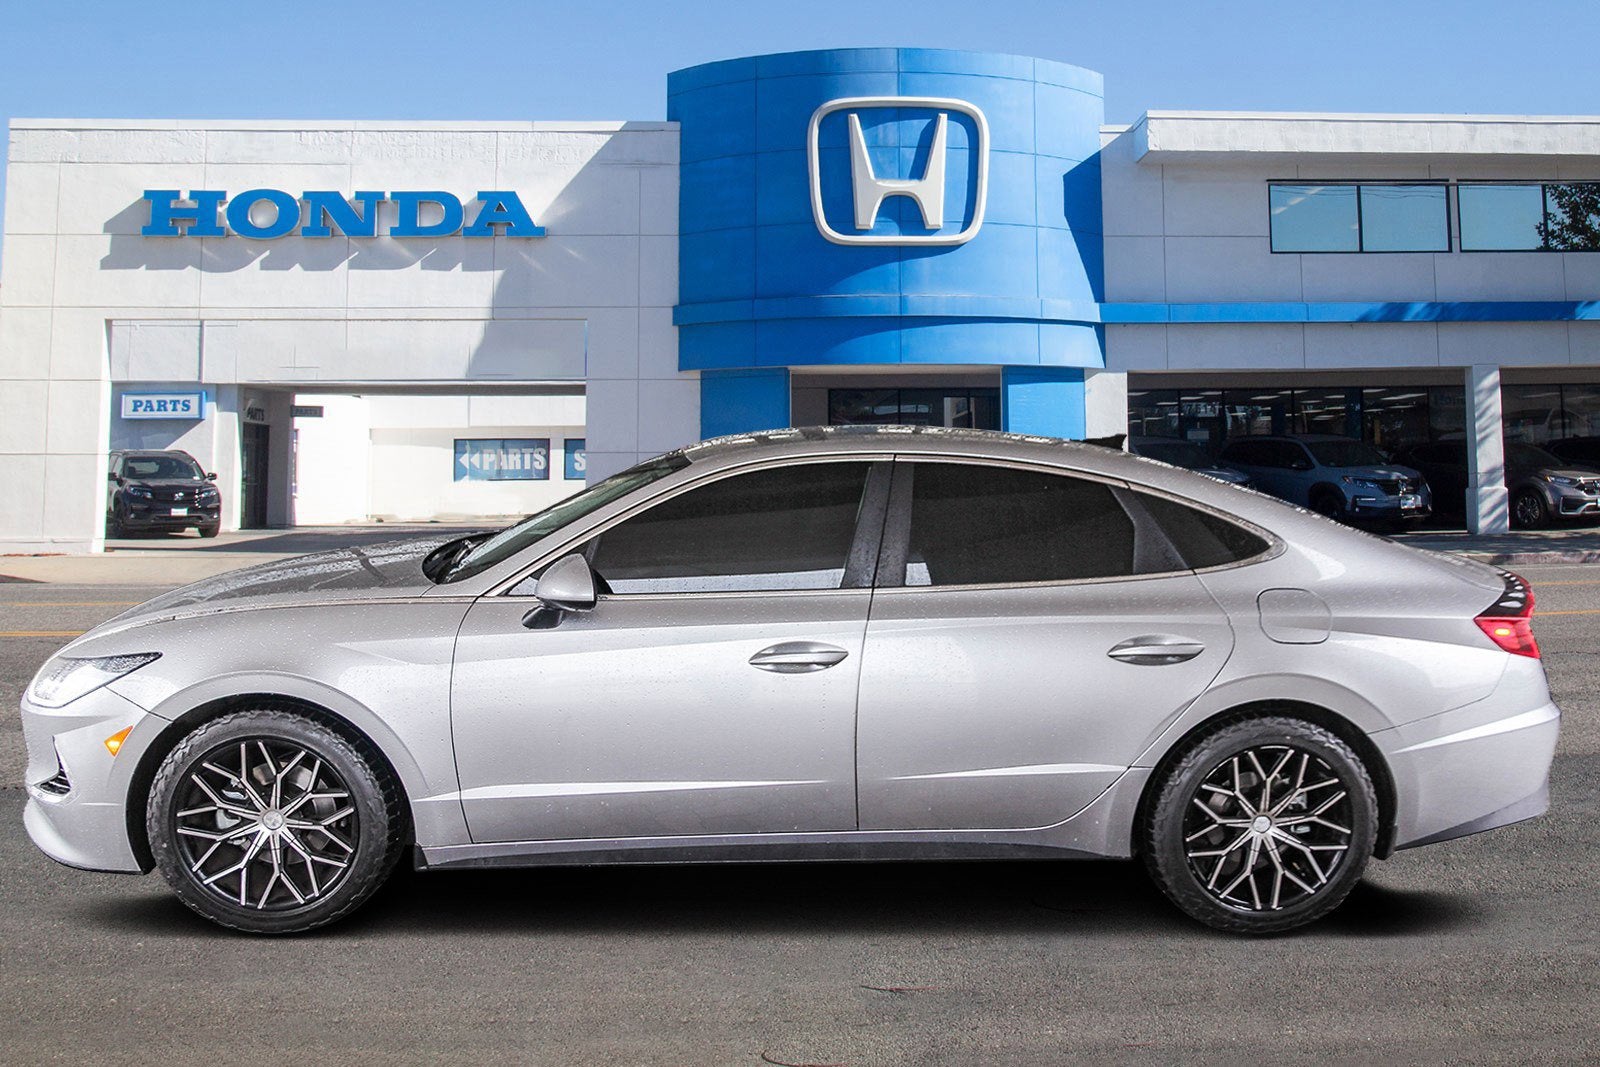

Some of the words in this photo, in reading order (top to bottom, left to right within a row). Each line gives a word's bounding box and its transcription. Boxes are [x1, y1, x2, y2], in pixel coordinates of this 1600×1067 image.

[141, 189, 547, 239] HONDA
[132, 399, 191, 412] PARTS
[482, 448, 547, 470] PARTS
